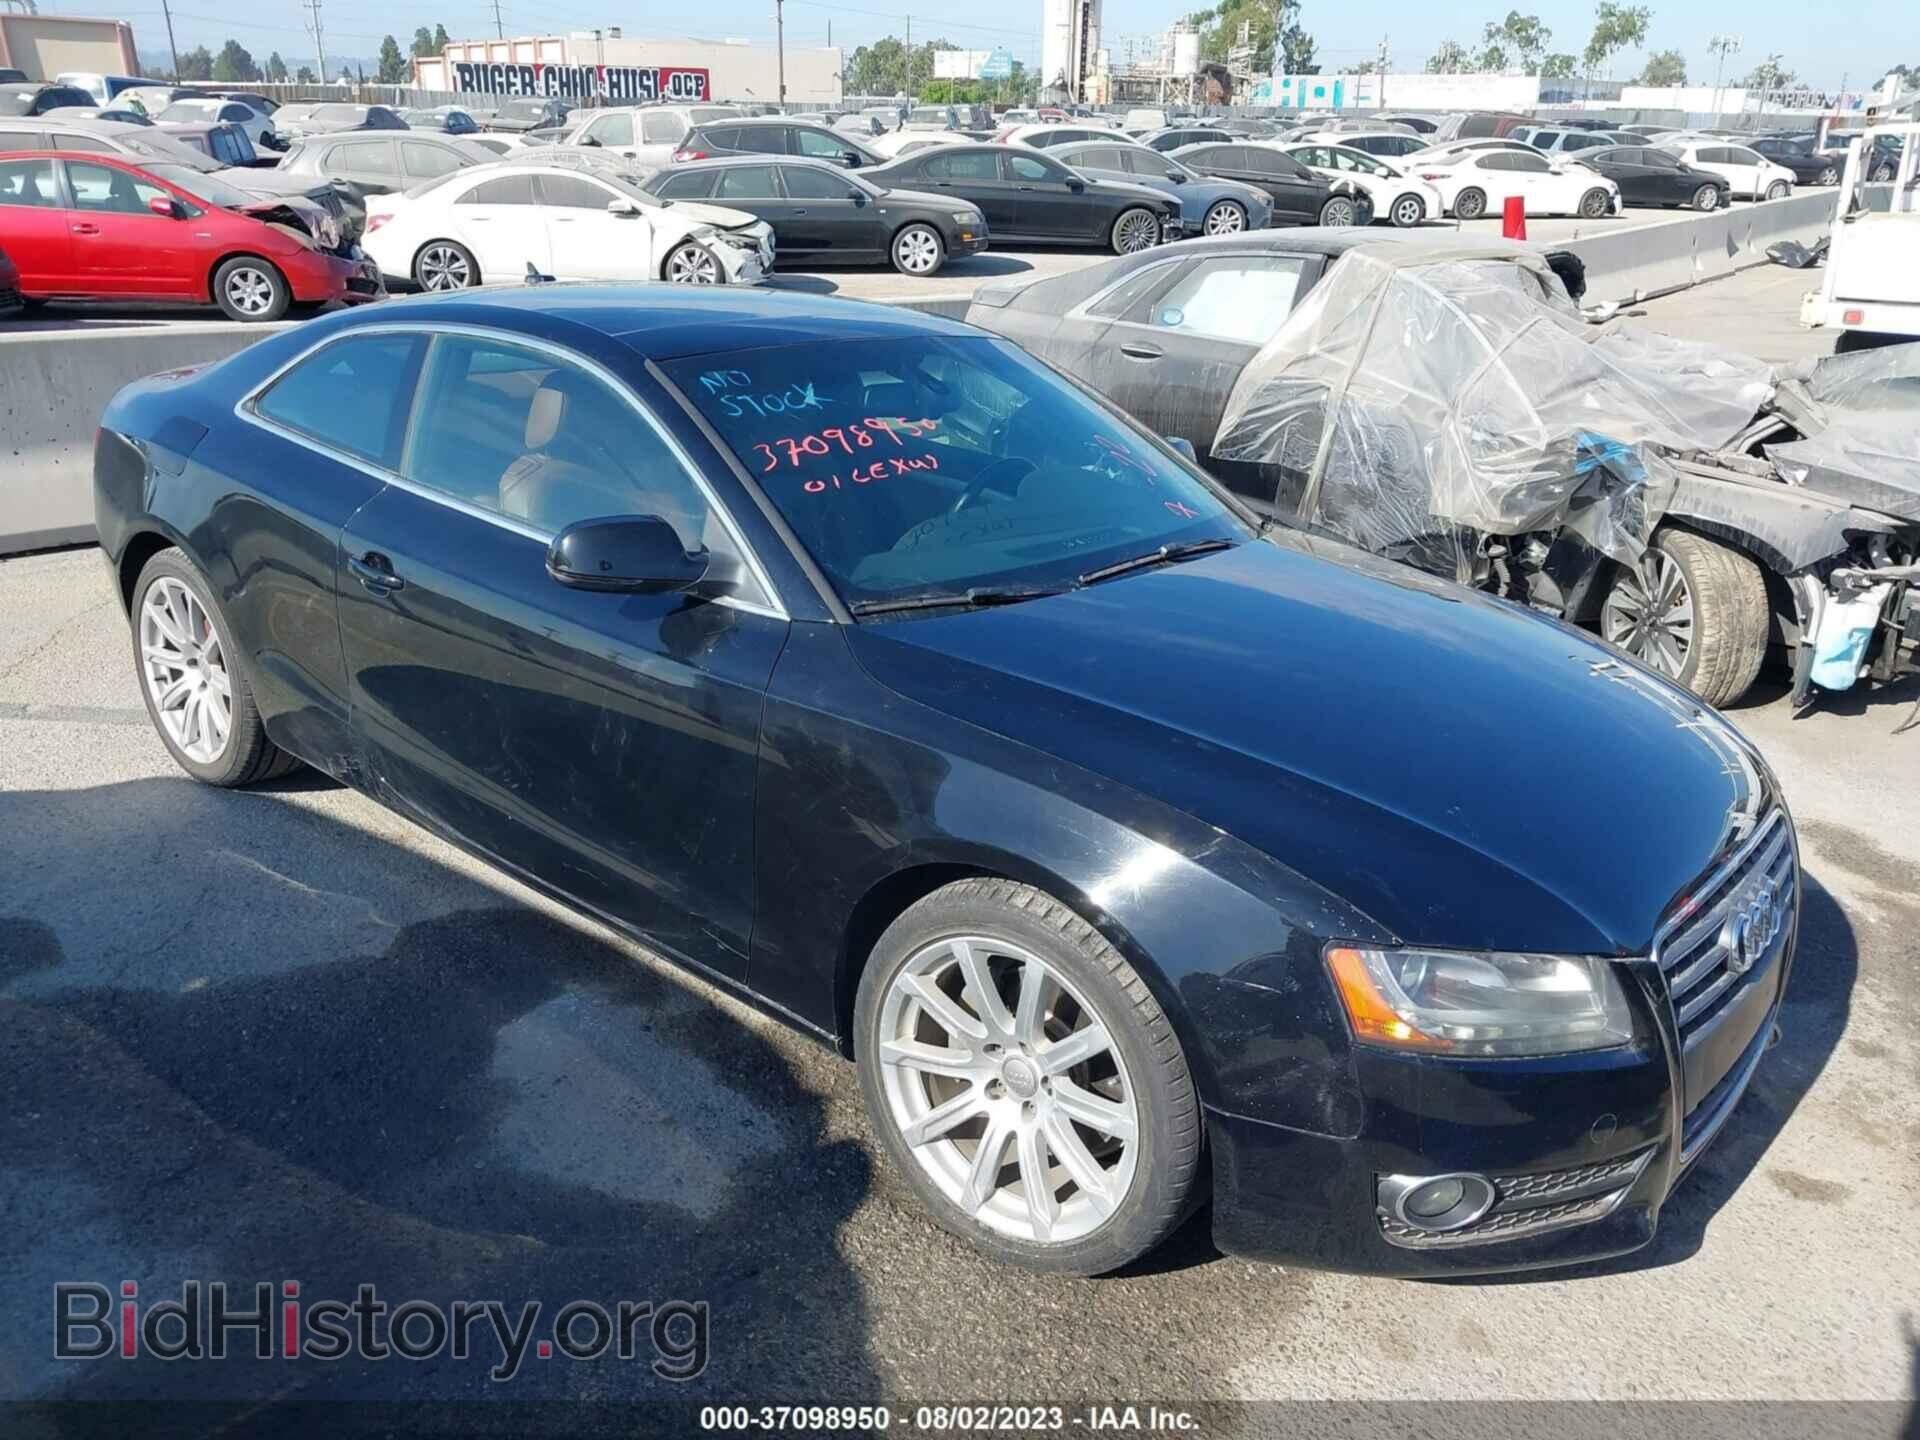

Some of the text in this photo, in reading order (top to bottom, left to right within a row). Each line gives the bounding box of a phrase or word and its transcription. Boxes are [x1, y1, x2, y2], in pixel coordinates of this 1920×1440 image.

[700, 370, 751, 394] NO
[720, 382, 832, 417] STOCK
[753, 416, 937, 472] 37098950
